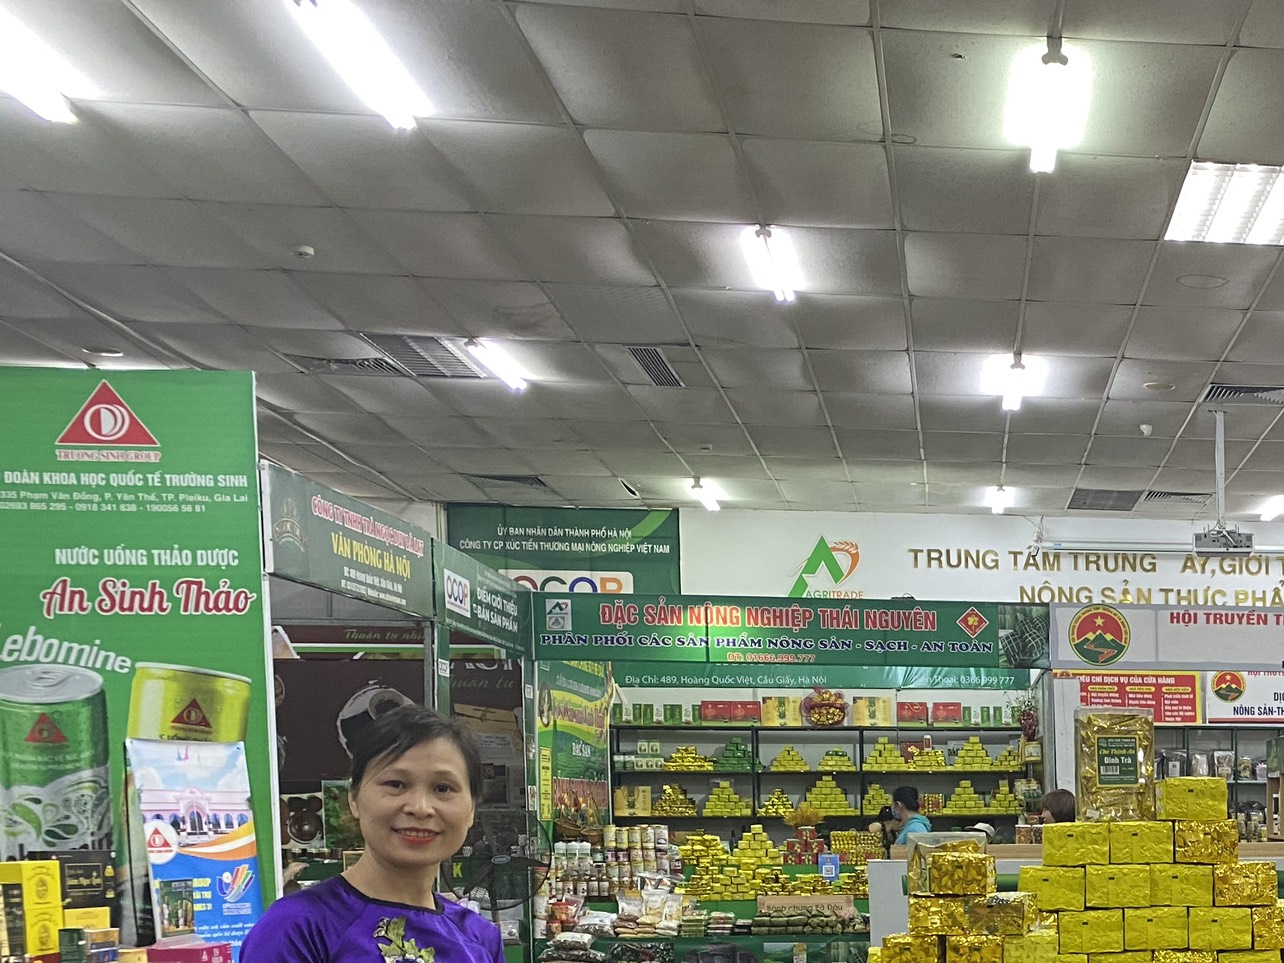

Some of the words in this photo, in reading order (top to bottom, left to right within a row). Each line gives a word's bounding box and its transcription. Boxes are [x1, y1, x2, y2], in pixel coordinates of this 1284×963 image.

[4, 470, 39, 484] ĐOÀN
[43, 473, 77, 485] KHOA
[80, 474, 105, 488] HỌC
[110, 470, 143, 486] QUỐC
[146, 470, 162, 487] TẾ
[165, 471, 215, 487] TRƯỜNG
[218, 475, 247, 487] SINH
[509, 528, 524, 536] BAN
[526, 527, 547, 537] NHÂN
[548, 527, 564, 537] DÂN
[565, 528, 589, 538] THÀNH
[55, 546, 99, 566] NƯỚC
[103, 543, 147, 566] UỐNG
[151, 544, 192, 566] THẢO
[197, 549, 238, 569] DƯỢC
[331, 531, 351, 559] VĂN
[352, 540, 382, 569] PHÒNG
[459, 539, 480, 549] CÔNG
[483, 541, 491, 549] TY
[493, 541, 504, 549] CP
[505, 539, 520, 550] XÚC
[540, 541, 569, 551] THƯƠNG
[585, 540, 606, 552] NÔNG
[653, 545, 669, 553] NAM
[908, 547, 999, 571] TRUNG
[41, 577, 91, 619] An
[96, 577, 170, 615] Sinh
[174, 579, 256, 615] Thảo
[804, 590, 864, 600] AGRITRADE
[1019, 580, 1093, 603] NÔNG
[1100, 579, 1151, 605] SẢN
[600, 600, 639, 629] ĐẶC
[643, 595, 683, 626] SẢN
[688, 601, 741, 627] NÔNG
[746, 602, 813, 632] NGHIỆP
[818, 605, 859, 630] THÁI
[864, 606, 937, 631] NGUYÊN
[1169, 610, 1198, 627] HỘI
[1203, 609, 1268, 625] TRUYỀN
[540, 632, 588, 646] PHÂN
[593, 631, 633, 646] PHỐI
[637, 633, 672, 647] CÁC
[676, 632, 710, 647] SẢN
[715, 633, 762, 648] PHẨM
[767, 634, 815, 650] NÔNG
[819, 636, 853, 650] SẢN
[864, 640, 909, 654] SẠCH
[920, 641, 944, 652] AN
[949, 639, 993, 653] TOÀN
[661, 675, 679, 685] 489,
[681, 676, 710, 686] Hoàng
[712, 675, 735, 684] Quốc
[1233, 706, 1255, 716] NÔNG
